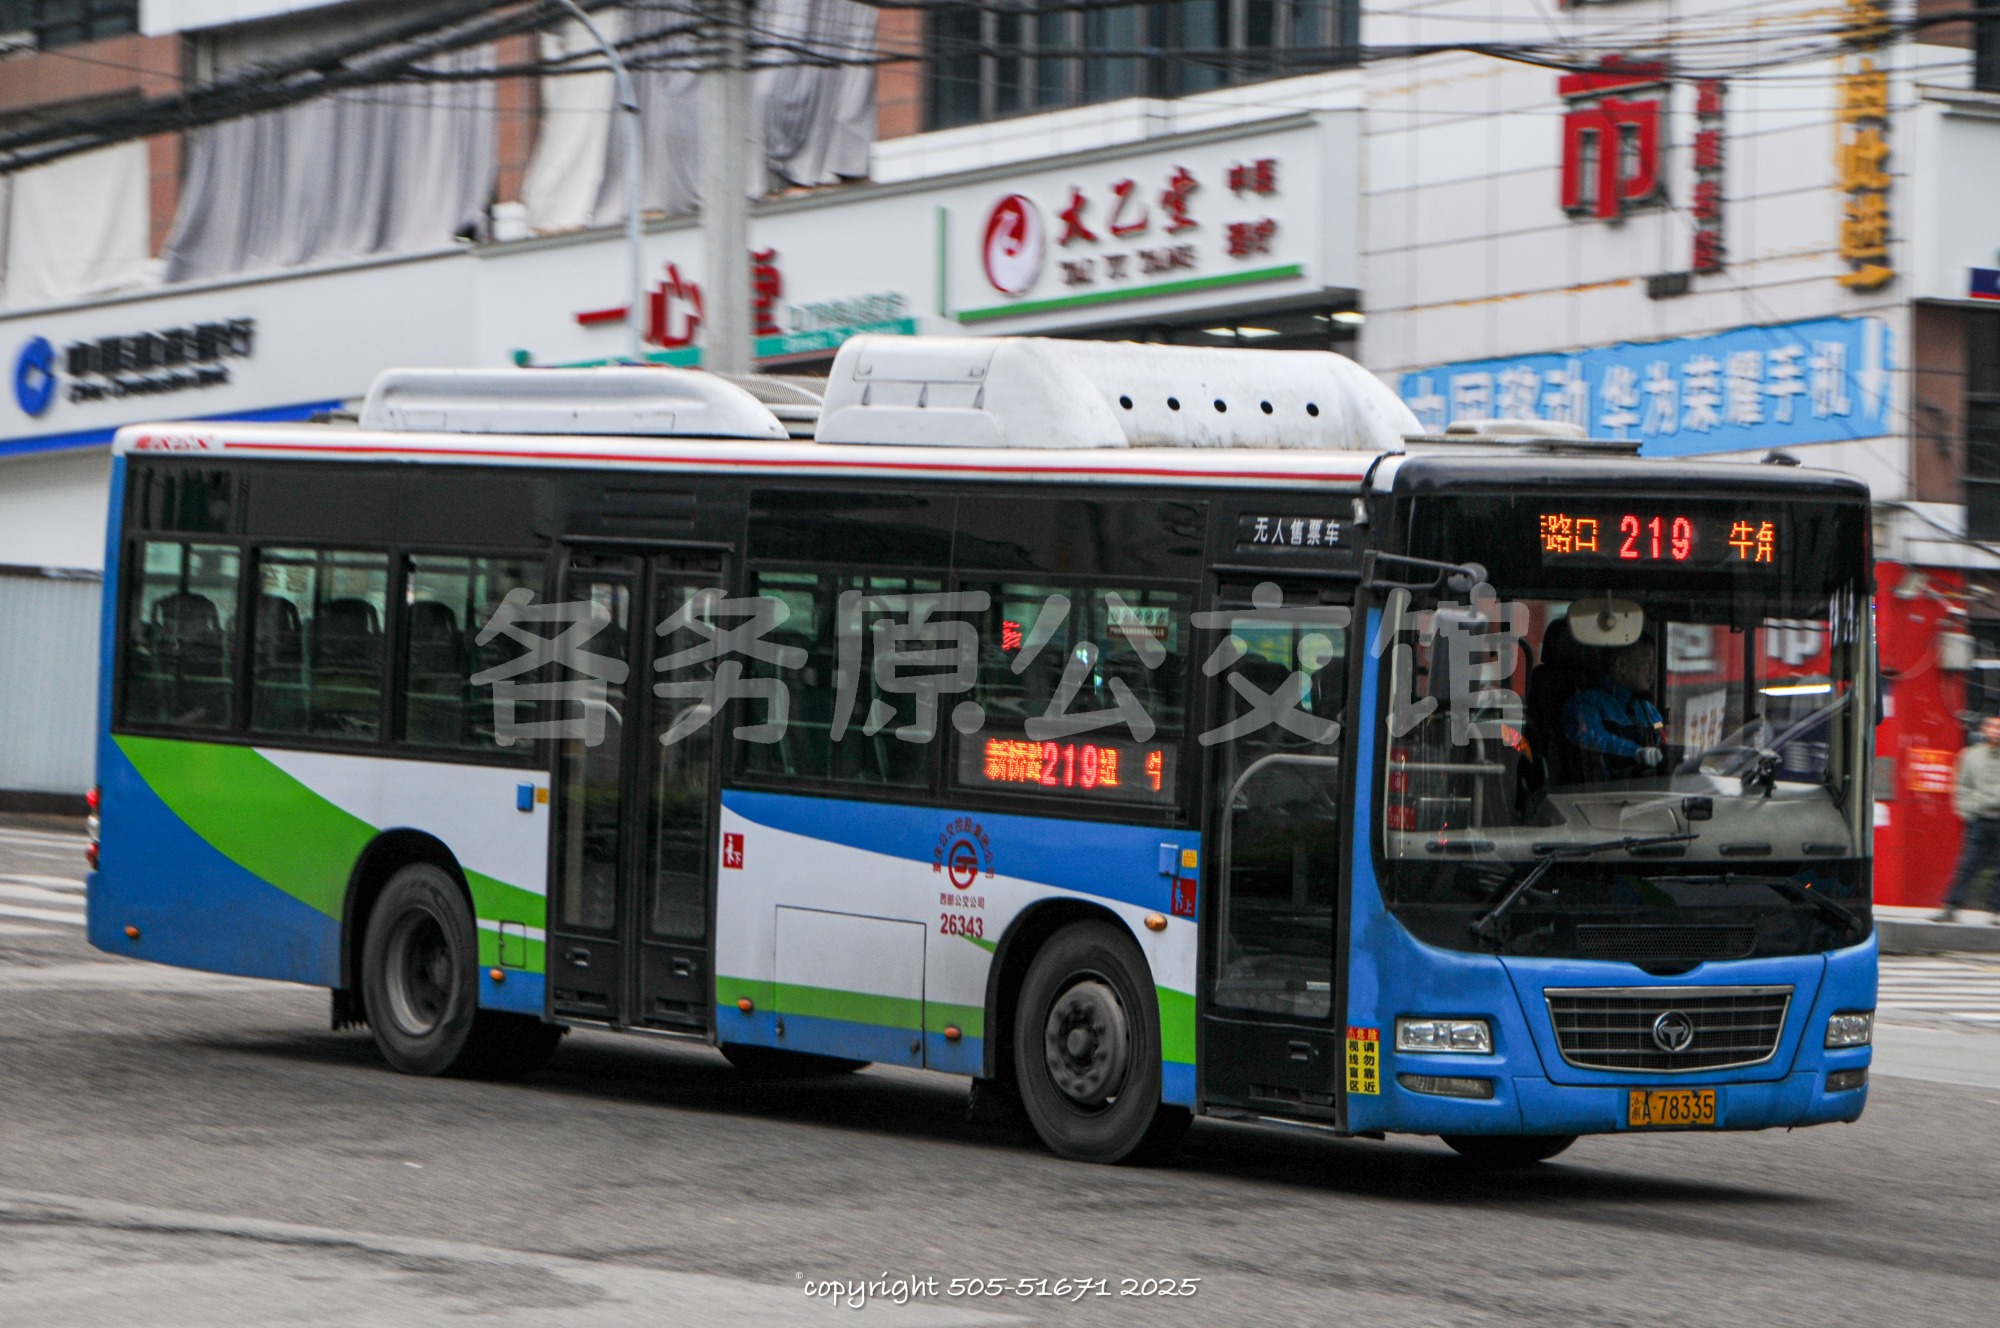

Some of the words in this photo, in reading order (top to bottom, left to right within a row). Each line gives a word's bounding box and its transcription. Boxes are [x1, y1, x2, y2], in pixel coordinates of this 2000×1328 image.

[1253, 516, 1341, 547] 无人售票车
[1540, 513, 1599, 553] 路口
[1619, 514, 1693, 560] 219
[1042, 741, 1098, 788] 219
[940, 892, 985, 910] 西部公交公司
[940, 912, 984, 940] 26343
[1356, 1029, 1378, 1040] 危险
[1348, 1040, 1360, 1092] 视线盲区
[1363, 1041, 1376, 1093] 请勿靠近
